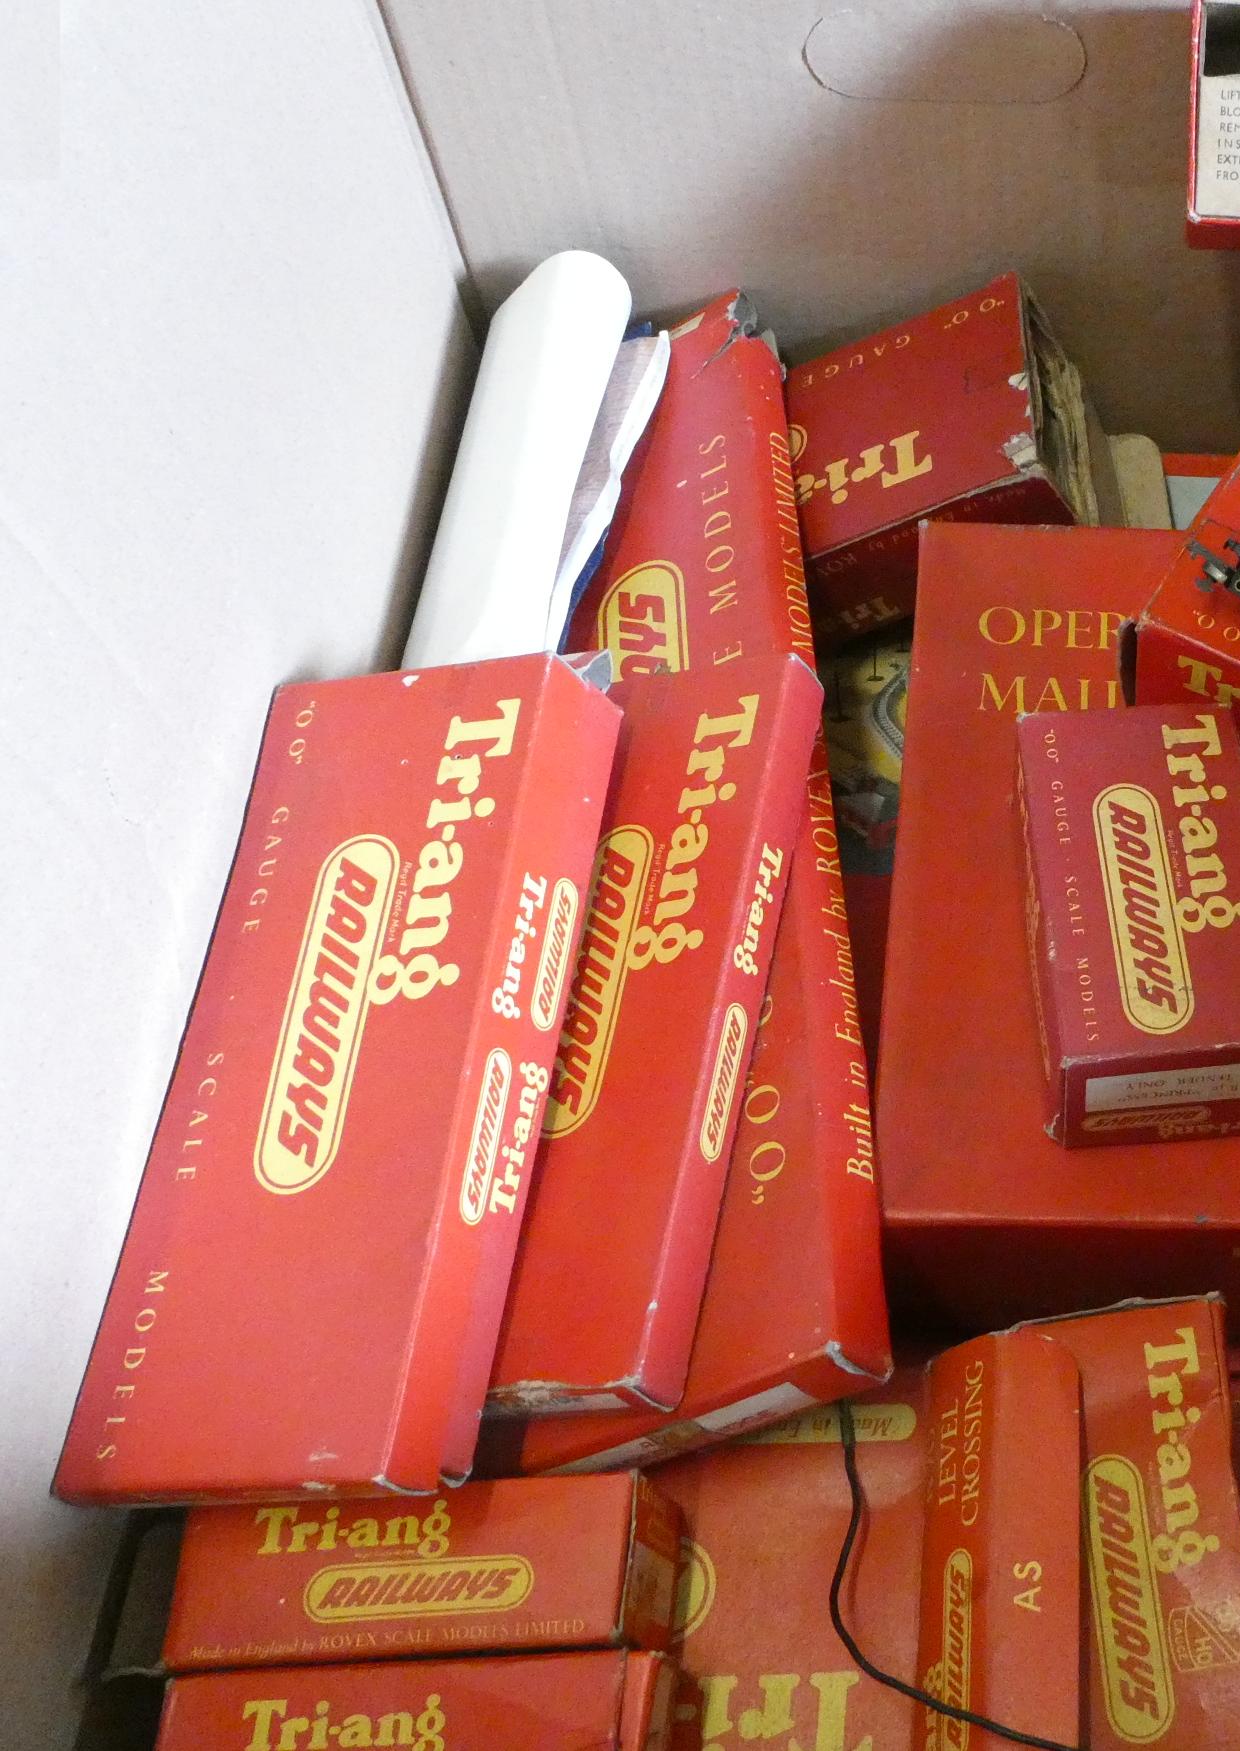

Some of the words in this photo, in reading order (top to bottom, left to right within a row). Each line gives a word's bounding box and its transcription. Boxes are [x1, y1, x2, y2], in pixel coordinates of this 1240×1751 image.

[699, 434, 738, 615] MODELS
[978, 606, 1127, 649] OPER
[241, 806, 290, 935] GAUGE
[366, 697, 522, 1005] Tri-ang
[626, 693, 760, 971] Tri-ang
[386, 918, 401, 944] Mark
[392, 889, 407, 918] Trade
[491, 871, 548, 1020] Tri-ang
[538, 887, 572, 1024] RAILWAYS
[733, 841, 783, 976] Tri-ang
[1050, 780, 1071, 845] GAUGE
[1064, 875, 1085, 936] SCALE
[1076, 957, 1100, 1042] MODELS
[1107, 800, 1178, 1015] RAILWAYS
[277, 856, 378, 1168] RAILWAYS
[549, 846, 636, 1116] RAILWAYS
[175, 1052, 225, 1182] SCALE
[467, 1057, 505, 1215] RAILWAYS
[488, 1061, 549, 1216] Tri-ang
[707, 1011, 743, 1150] RAILWAYS
[843, 1098, 874, 1184] Built
[844, 1060, 867, 1089] in
[95, 1270, 170, 1460] MODELS
[938, 1397, 960, 1507] LEVEL
[960, 1359, 985, 1527] CROSSING
[1143, 1327, 1221, 1575] Tri-ang
[256, 1499, 452, 1558] Tri-ang
[317, 1566, 522, 1611] RAILWAYS
[1093, 1473, 1160, 1722] RAILWAYS
[244, 1638, 299, 1660] England
[319, 1631, 377, 1650] ROVEX
[384, 1628, 432, 1646] SCALE
[443, 1624, 510, 1642] MODELS
[515, 1618, 586, 1639] LIMITED
[242, 1693, 446, 1751] Tri-ang
